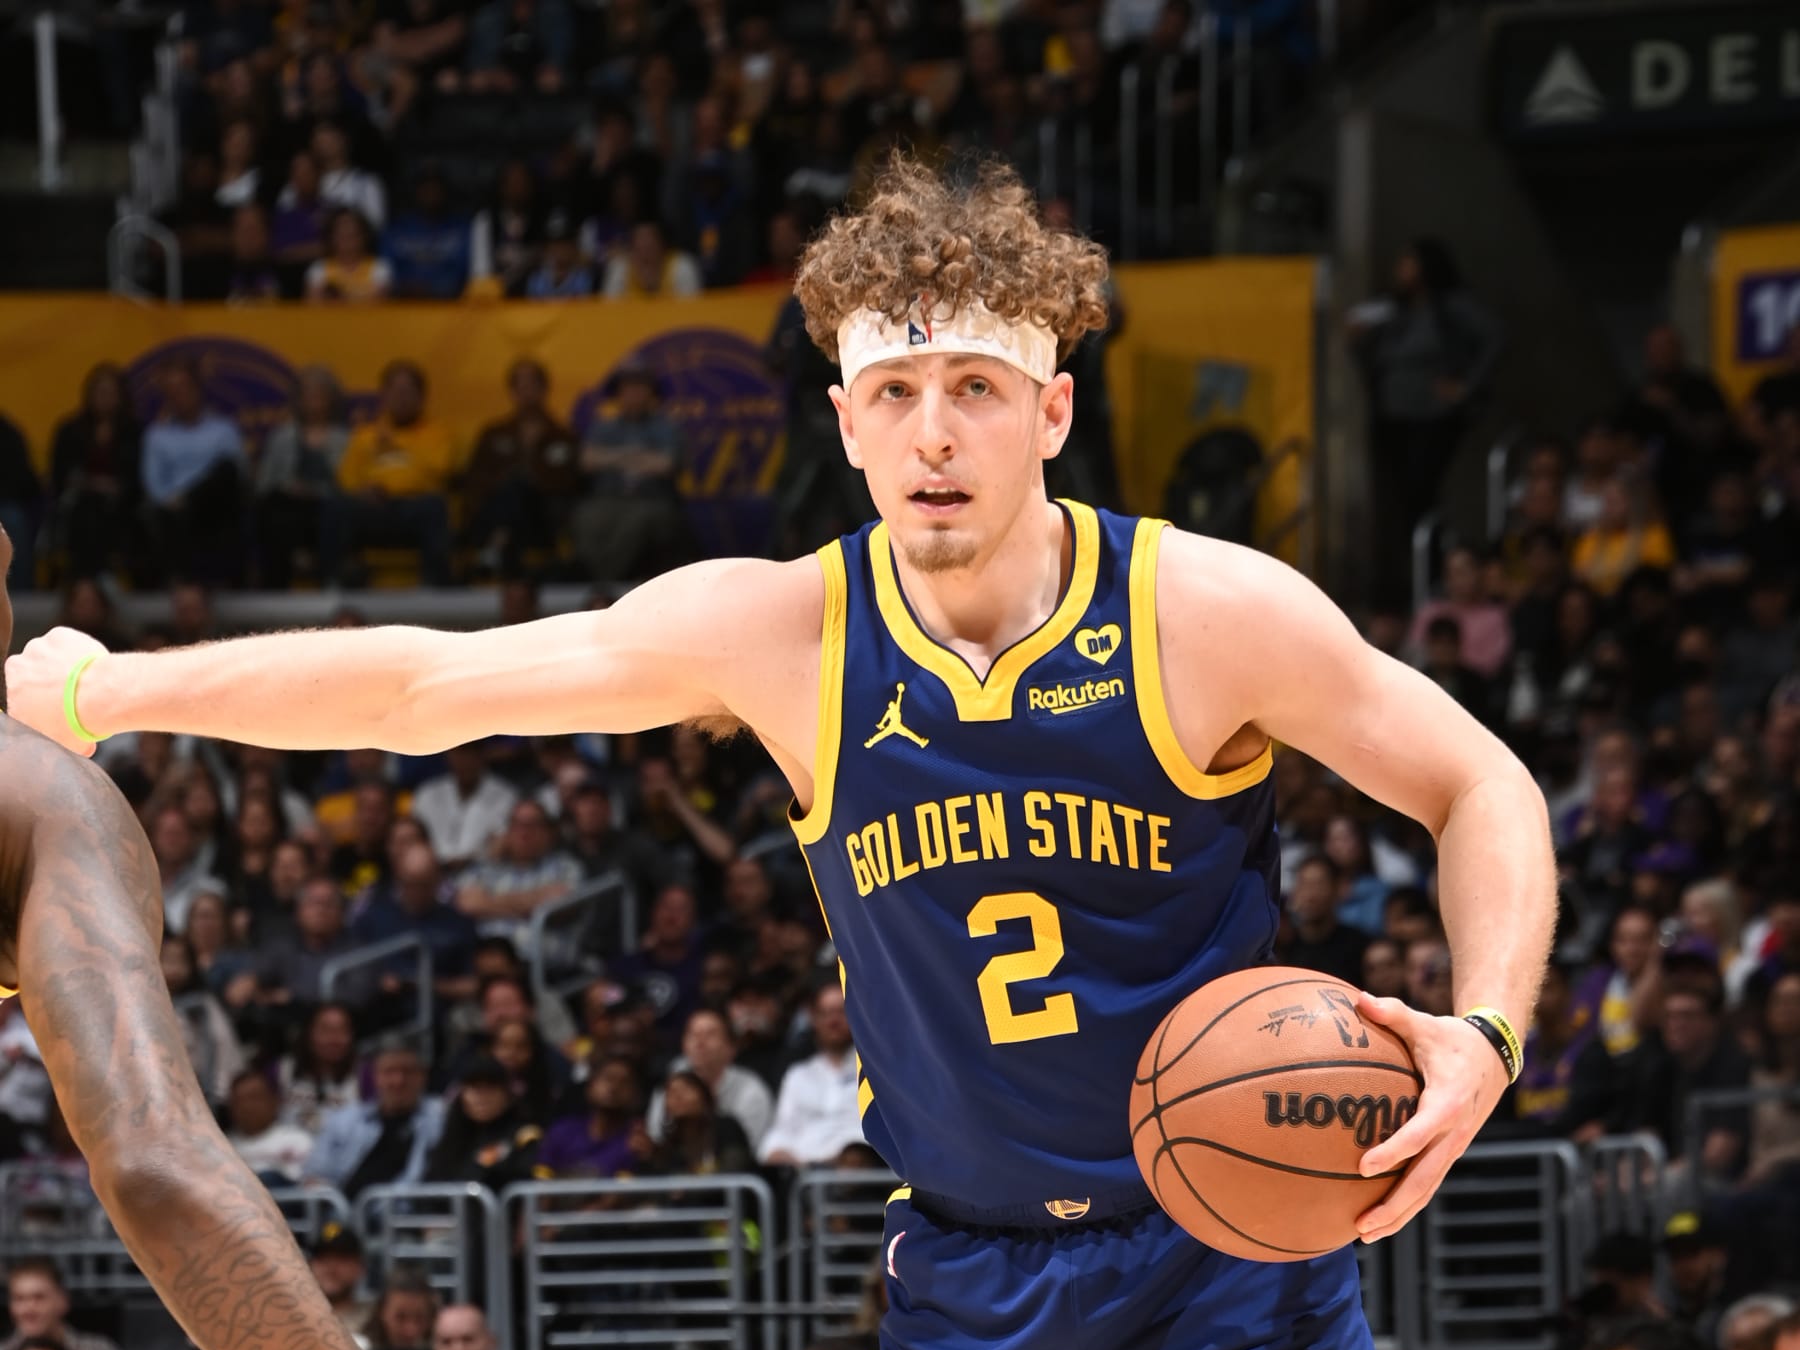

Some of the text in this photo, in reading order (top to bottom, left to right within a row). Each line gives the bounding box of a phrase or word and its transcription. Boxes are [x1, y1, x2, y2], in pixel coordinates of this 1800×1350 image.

[1086, 634, 1112, 655] DM
[1028, 678, 1126, 711] Rakuten
[845, 790, 1172, 897] GOLDEN STATE
[966, 891, 1079, 1045] 2
